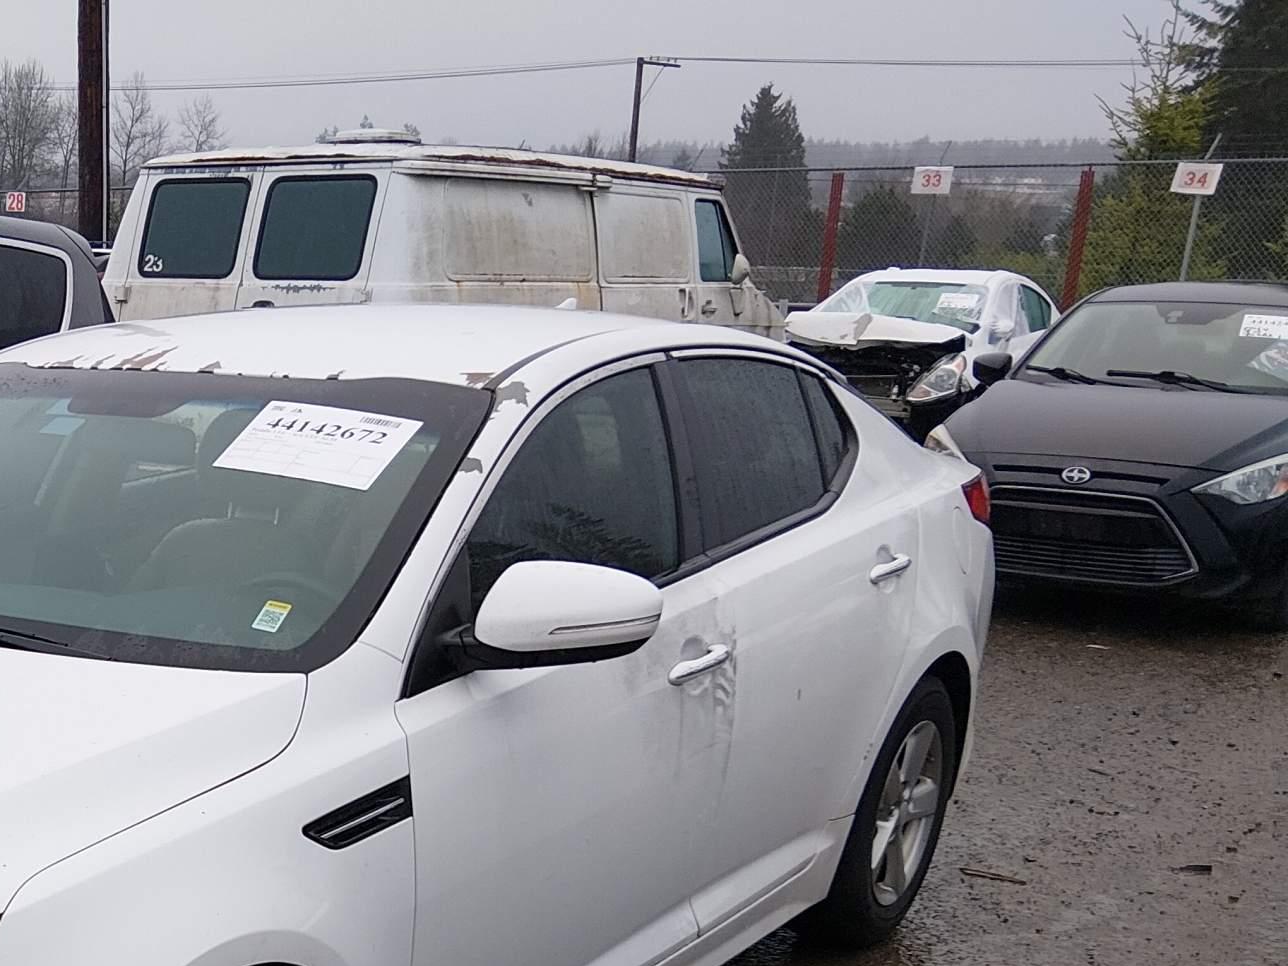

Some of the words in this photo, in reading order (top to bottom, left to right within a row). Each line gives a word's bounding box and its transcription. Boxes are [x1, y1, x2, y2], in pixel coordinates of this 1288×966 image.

[921, 174, 942, 188] 33
[1183, 171, 1209, 188] 34
[7, 193, 24, 212] 28
[143, 254, 163, 272] 23
[266, 417, 388, 445] 44142672
